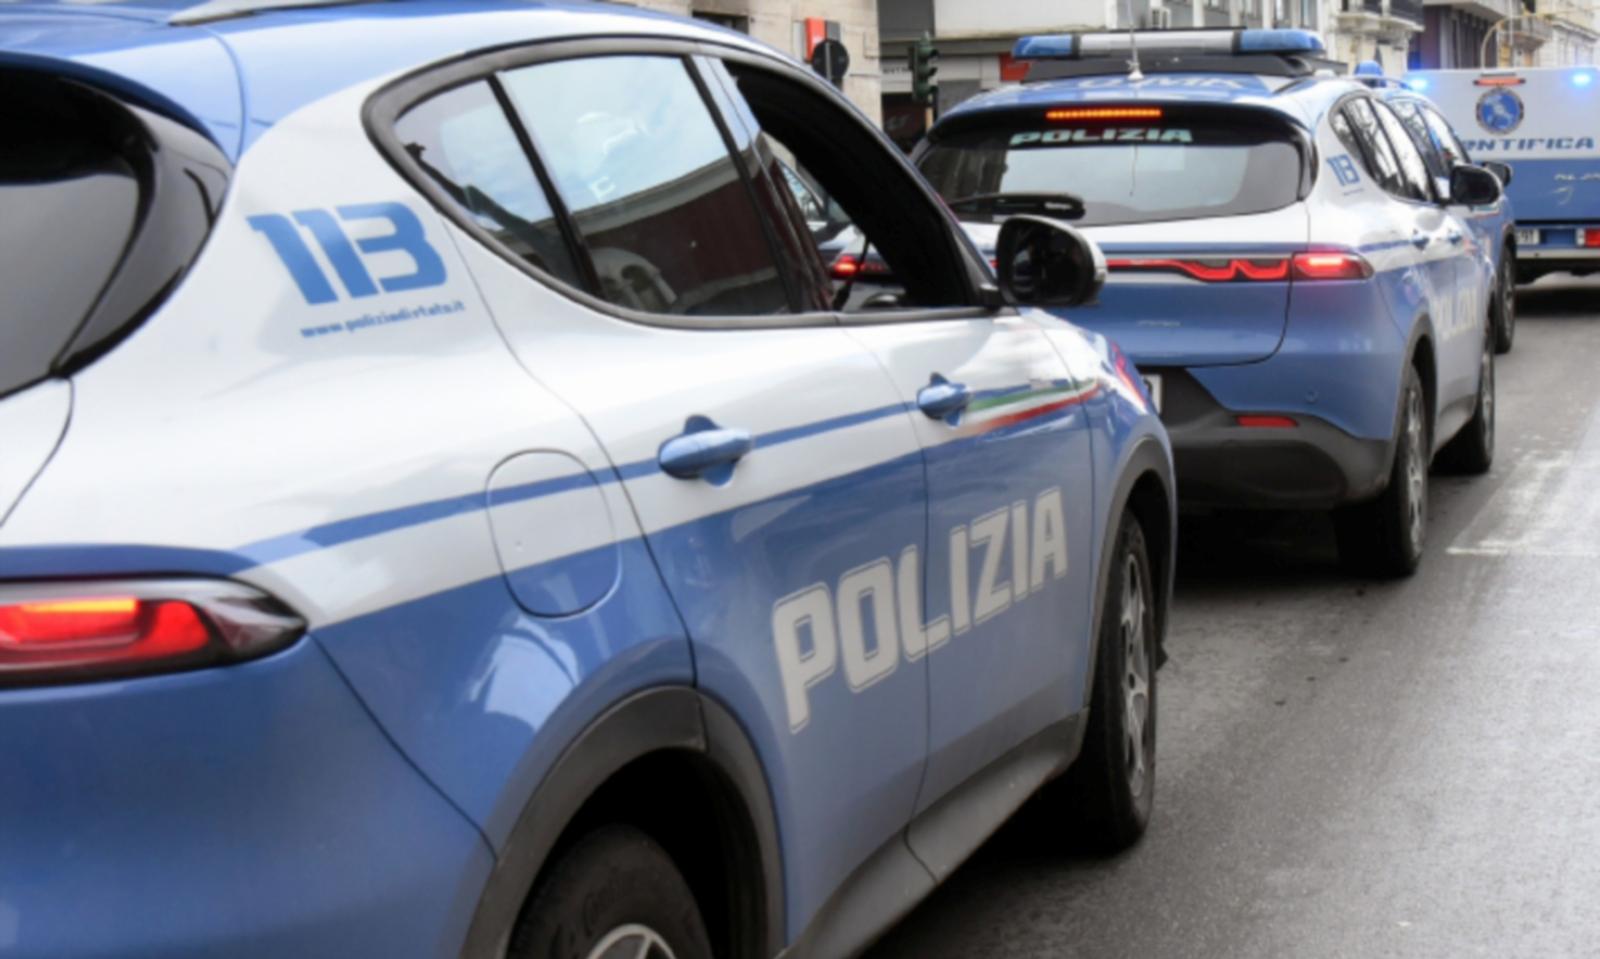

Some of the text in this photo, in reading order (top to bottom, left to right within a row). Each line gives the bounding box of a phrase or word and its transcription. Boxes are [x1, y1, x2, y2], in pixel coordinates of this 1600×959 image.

[1009, 128, 1193, 146] POLIZIA
[245, 201, 448, 305] 113
[771, 485, 1069, 735] POLIZIA
